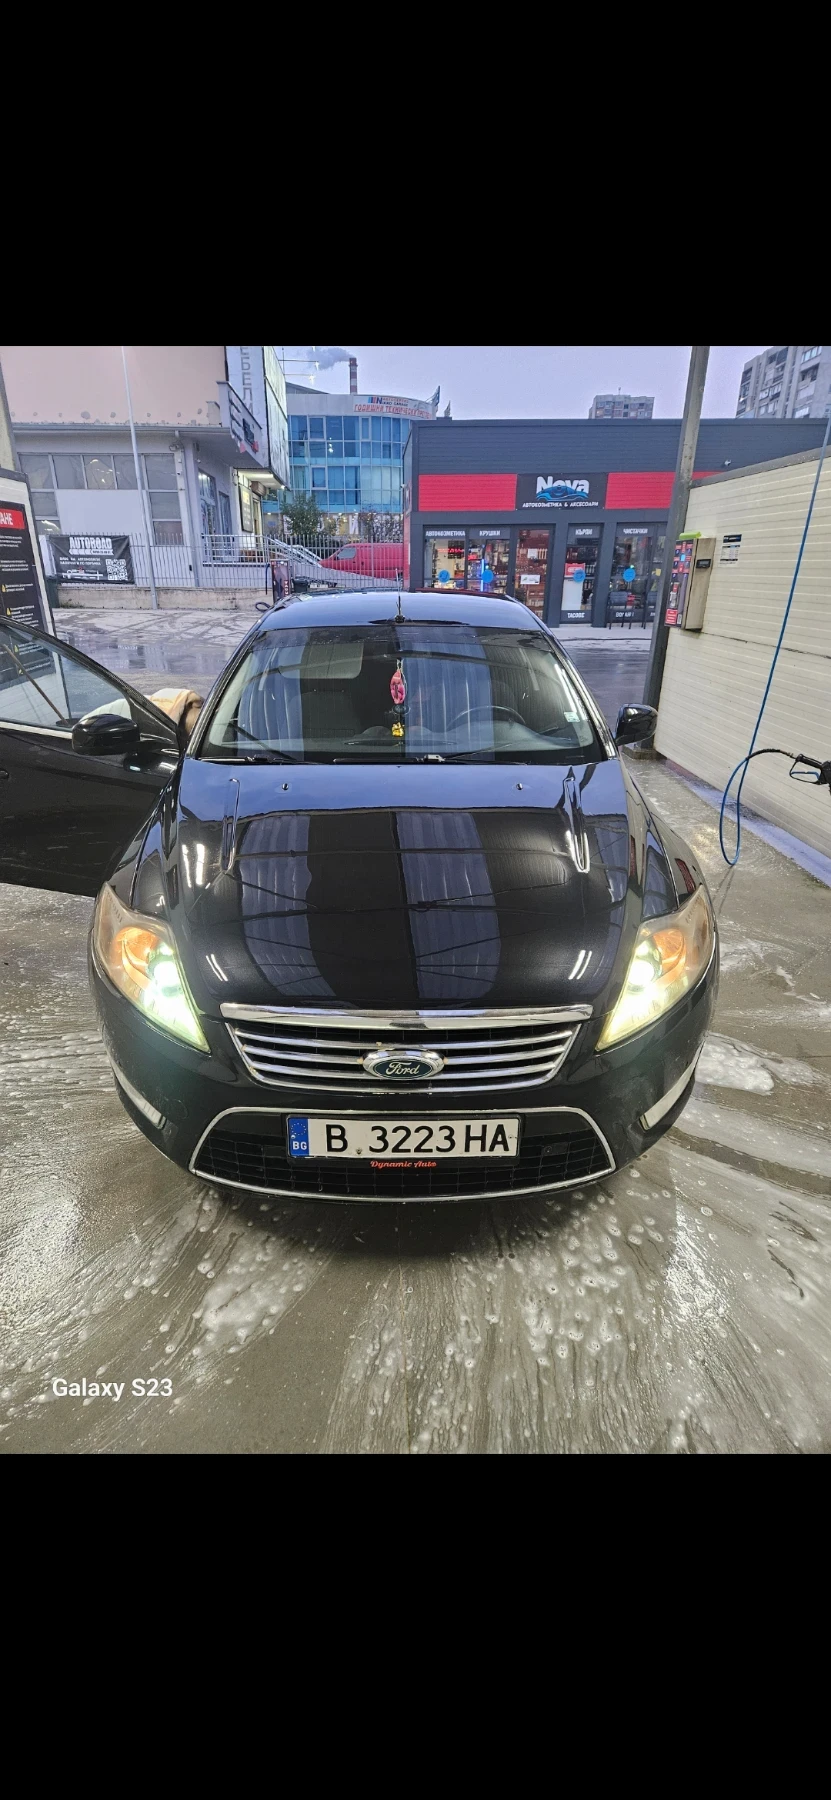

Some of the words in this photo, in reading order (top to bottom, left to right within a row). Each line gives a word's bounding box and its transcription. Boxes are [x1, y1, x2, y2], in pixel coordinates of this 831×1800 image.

[536, 476, 590, 494] Nova
[69, 537, 112, 549] AUTOROAD
[385, 1061, 421, 1075] Ford
[292, 1141, 307, 1150] BG
[325, 1124, 348, 1152] B
[369, 1125, 455, 1153] 3223
[464, 1124, 509, 1152] HA
[370, 1160, 412, 1169] Dynamic
[413, 1160, 437, 1168] Auto
